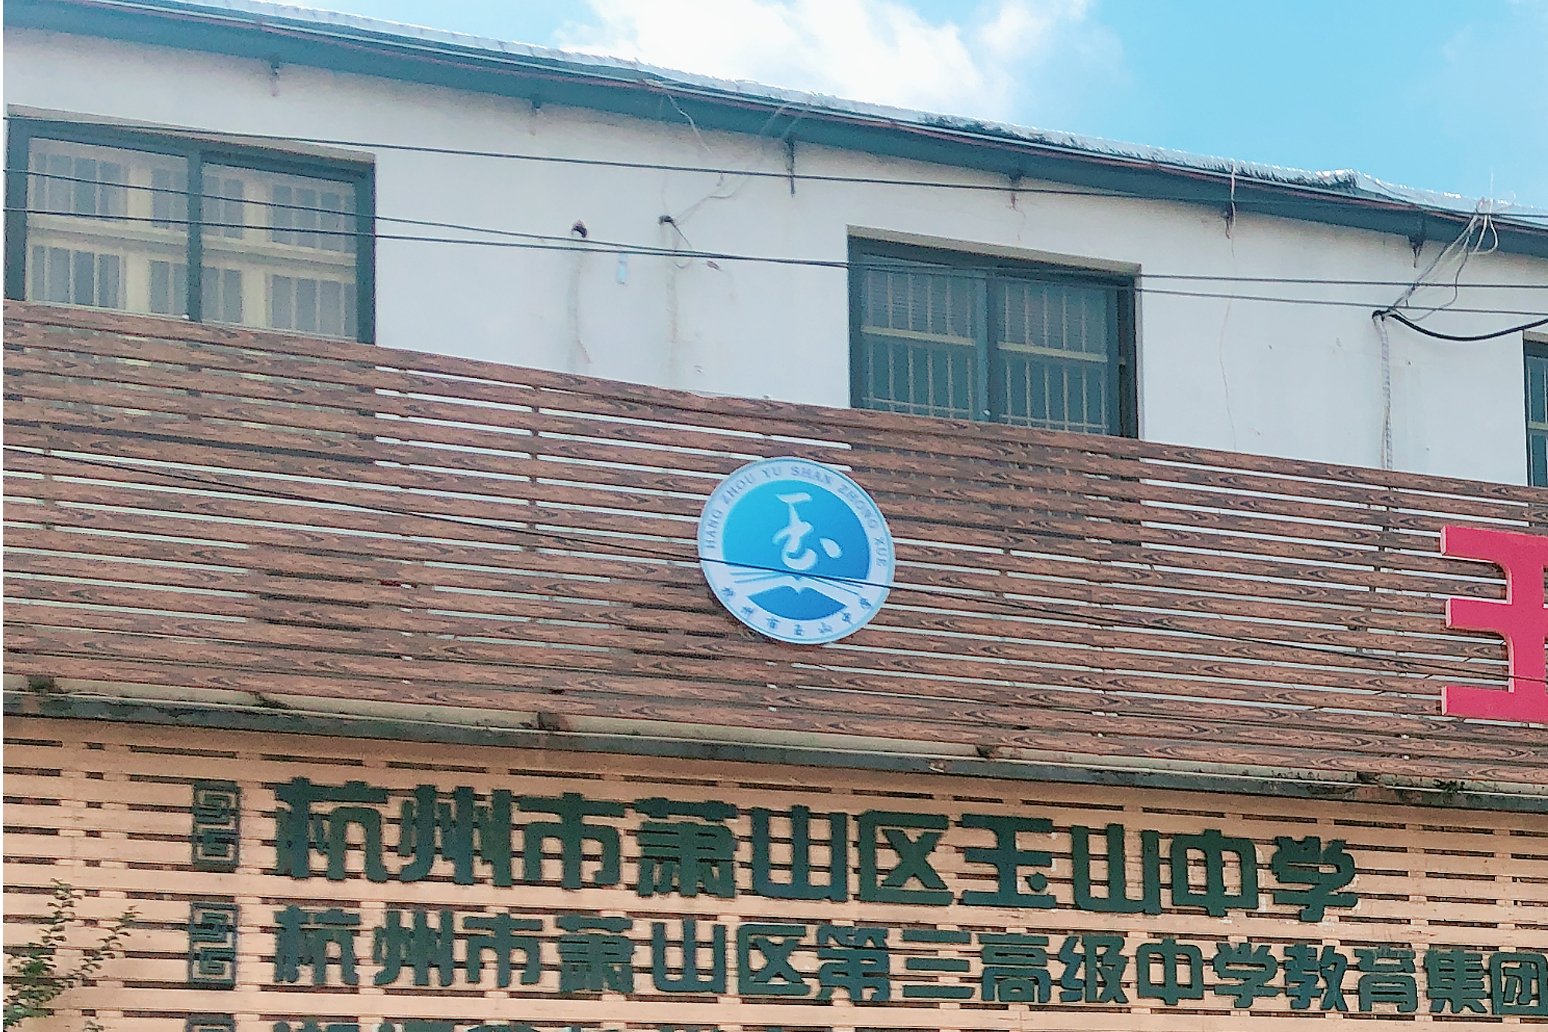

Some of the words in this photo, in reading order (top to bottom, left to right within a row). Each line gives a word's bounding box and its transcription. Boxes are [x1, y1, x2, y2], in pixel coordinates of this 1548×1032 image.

[273, 776, 1360, 923] 杭州市萧山区玉山中学
